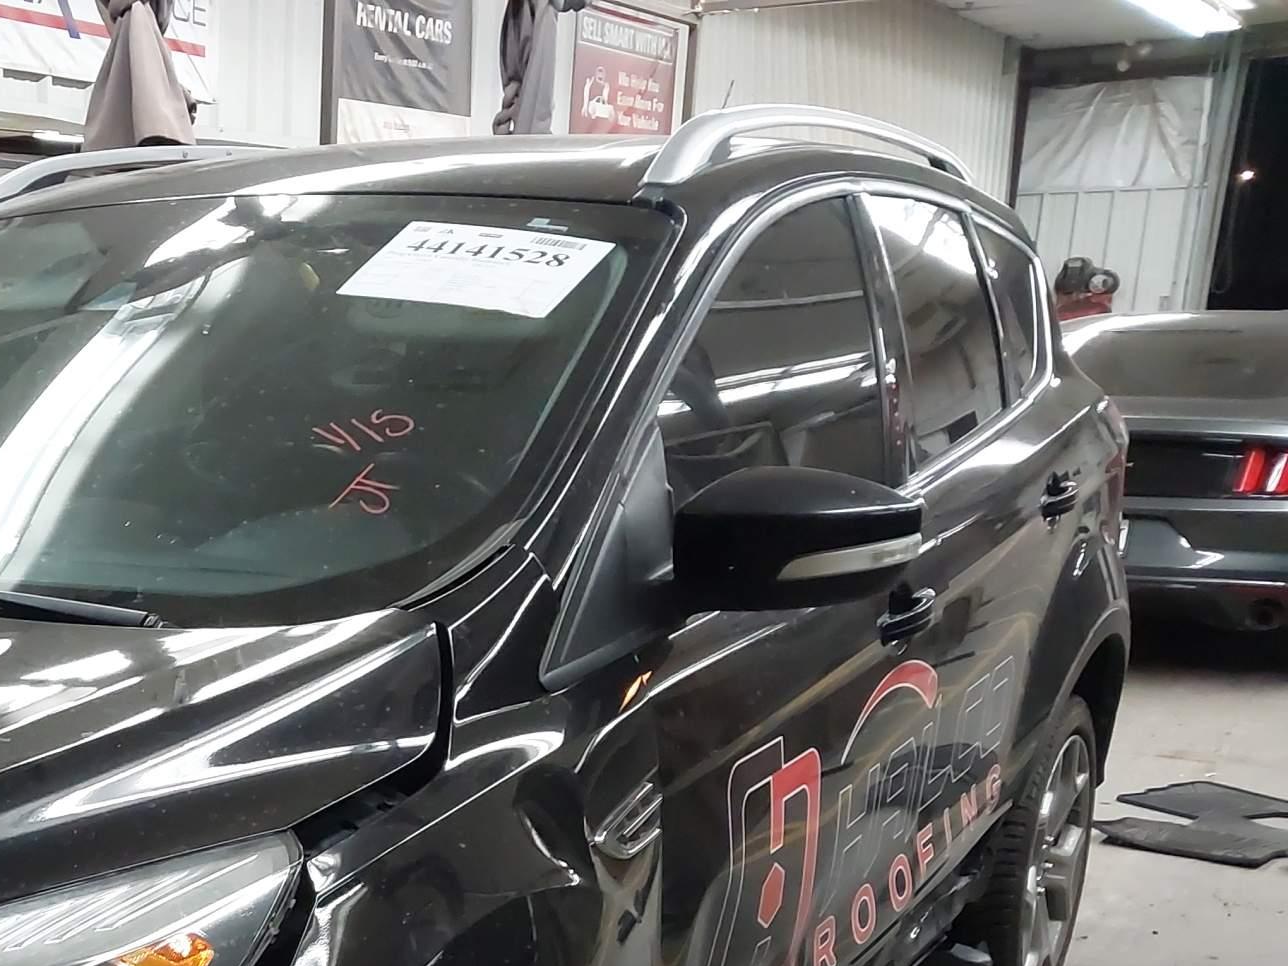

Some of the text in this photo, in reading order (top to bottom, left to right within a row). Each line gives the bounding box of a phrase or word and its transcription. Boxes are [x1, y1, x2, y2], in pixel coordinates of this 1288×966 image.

[356, 1, 452, 44] RENTAL CARS
[583, 16, 602, 42] SELL
[603, 22, 634, 49] SMART
[407, 239, 570, 267] 44141528
